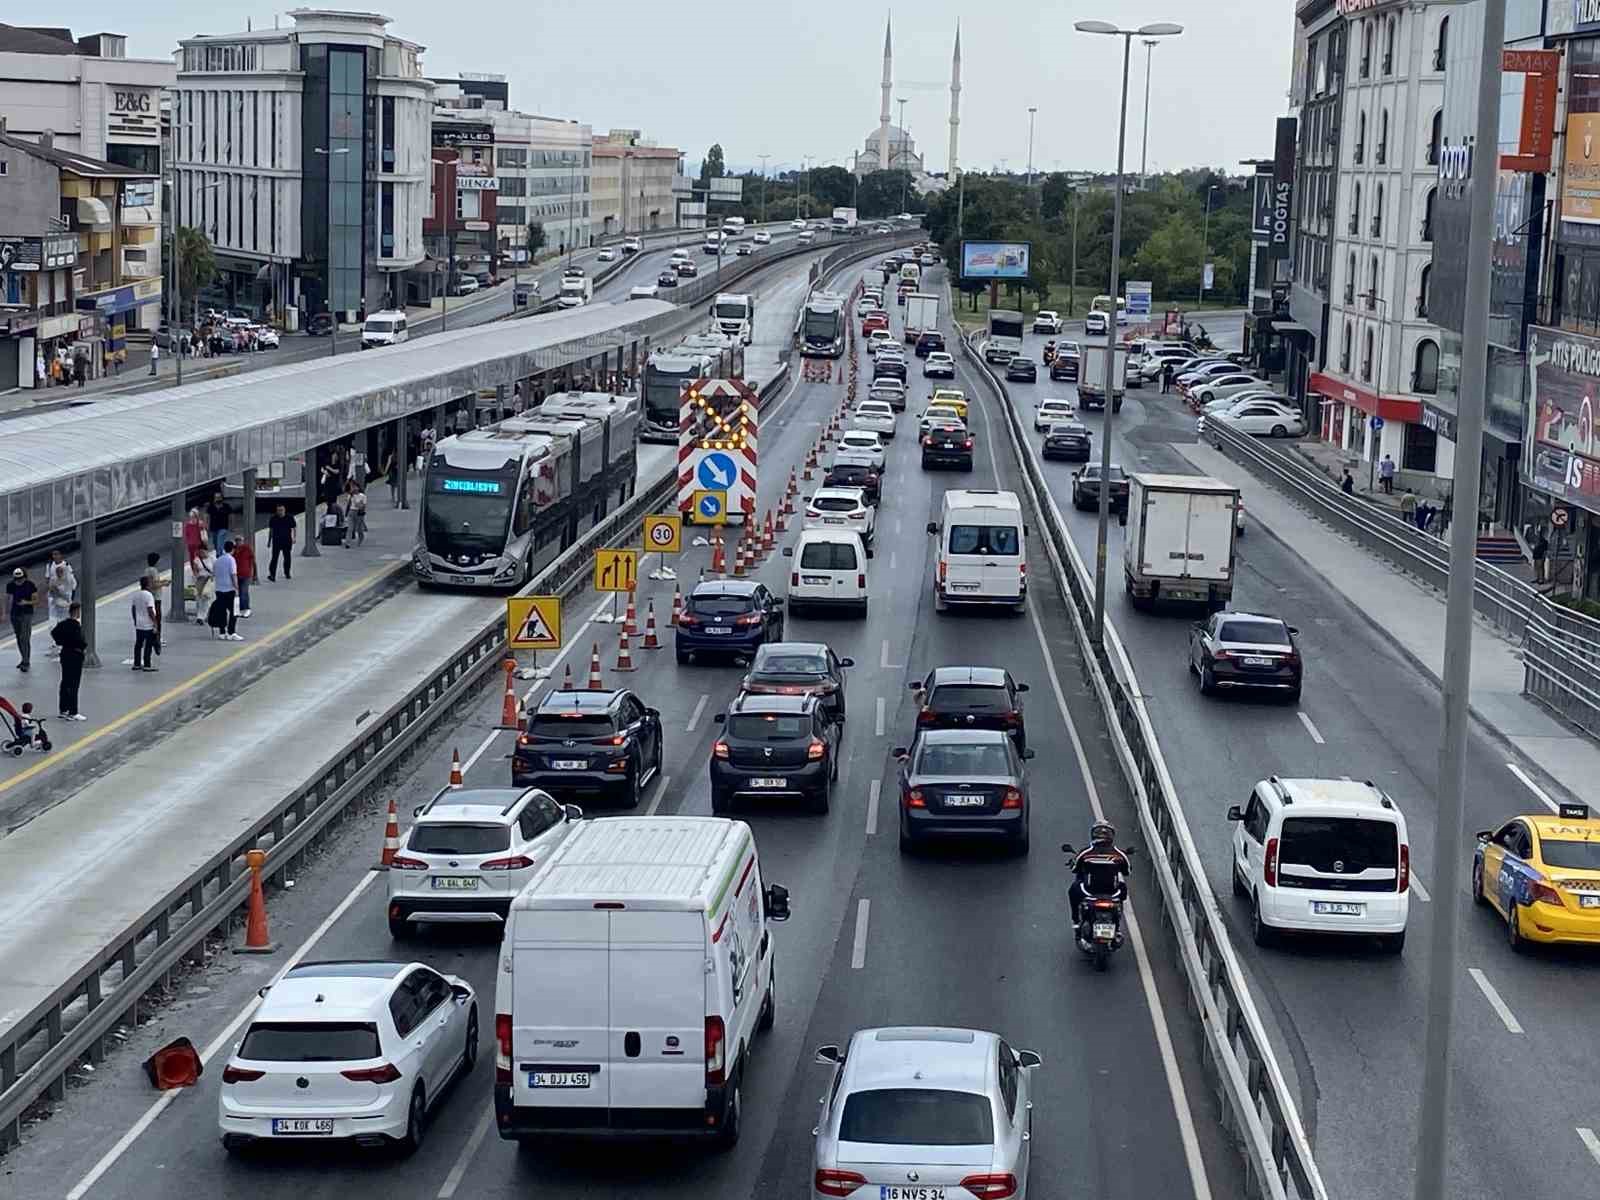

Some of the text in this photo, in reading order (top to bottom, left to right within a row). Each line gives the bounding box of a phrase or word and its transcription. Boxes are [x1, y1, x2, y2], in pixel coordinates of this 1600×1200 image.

[114, 91, 151, 112] E&G
[654, 528, 671, 540] 30
[535, 1073, 546, 1085] 34
[279, 1120, 289, 1130] 34
[886, 1187, 945, 1200] 16 NVS 34
